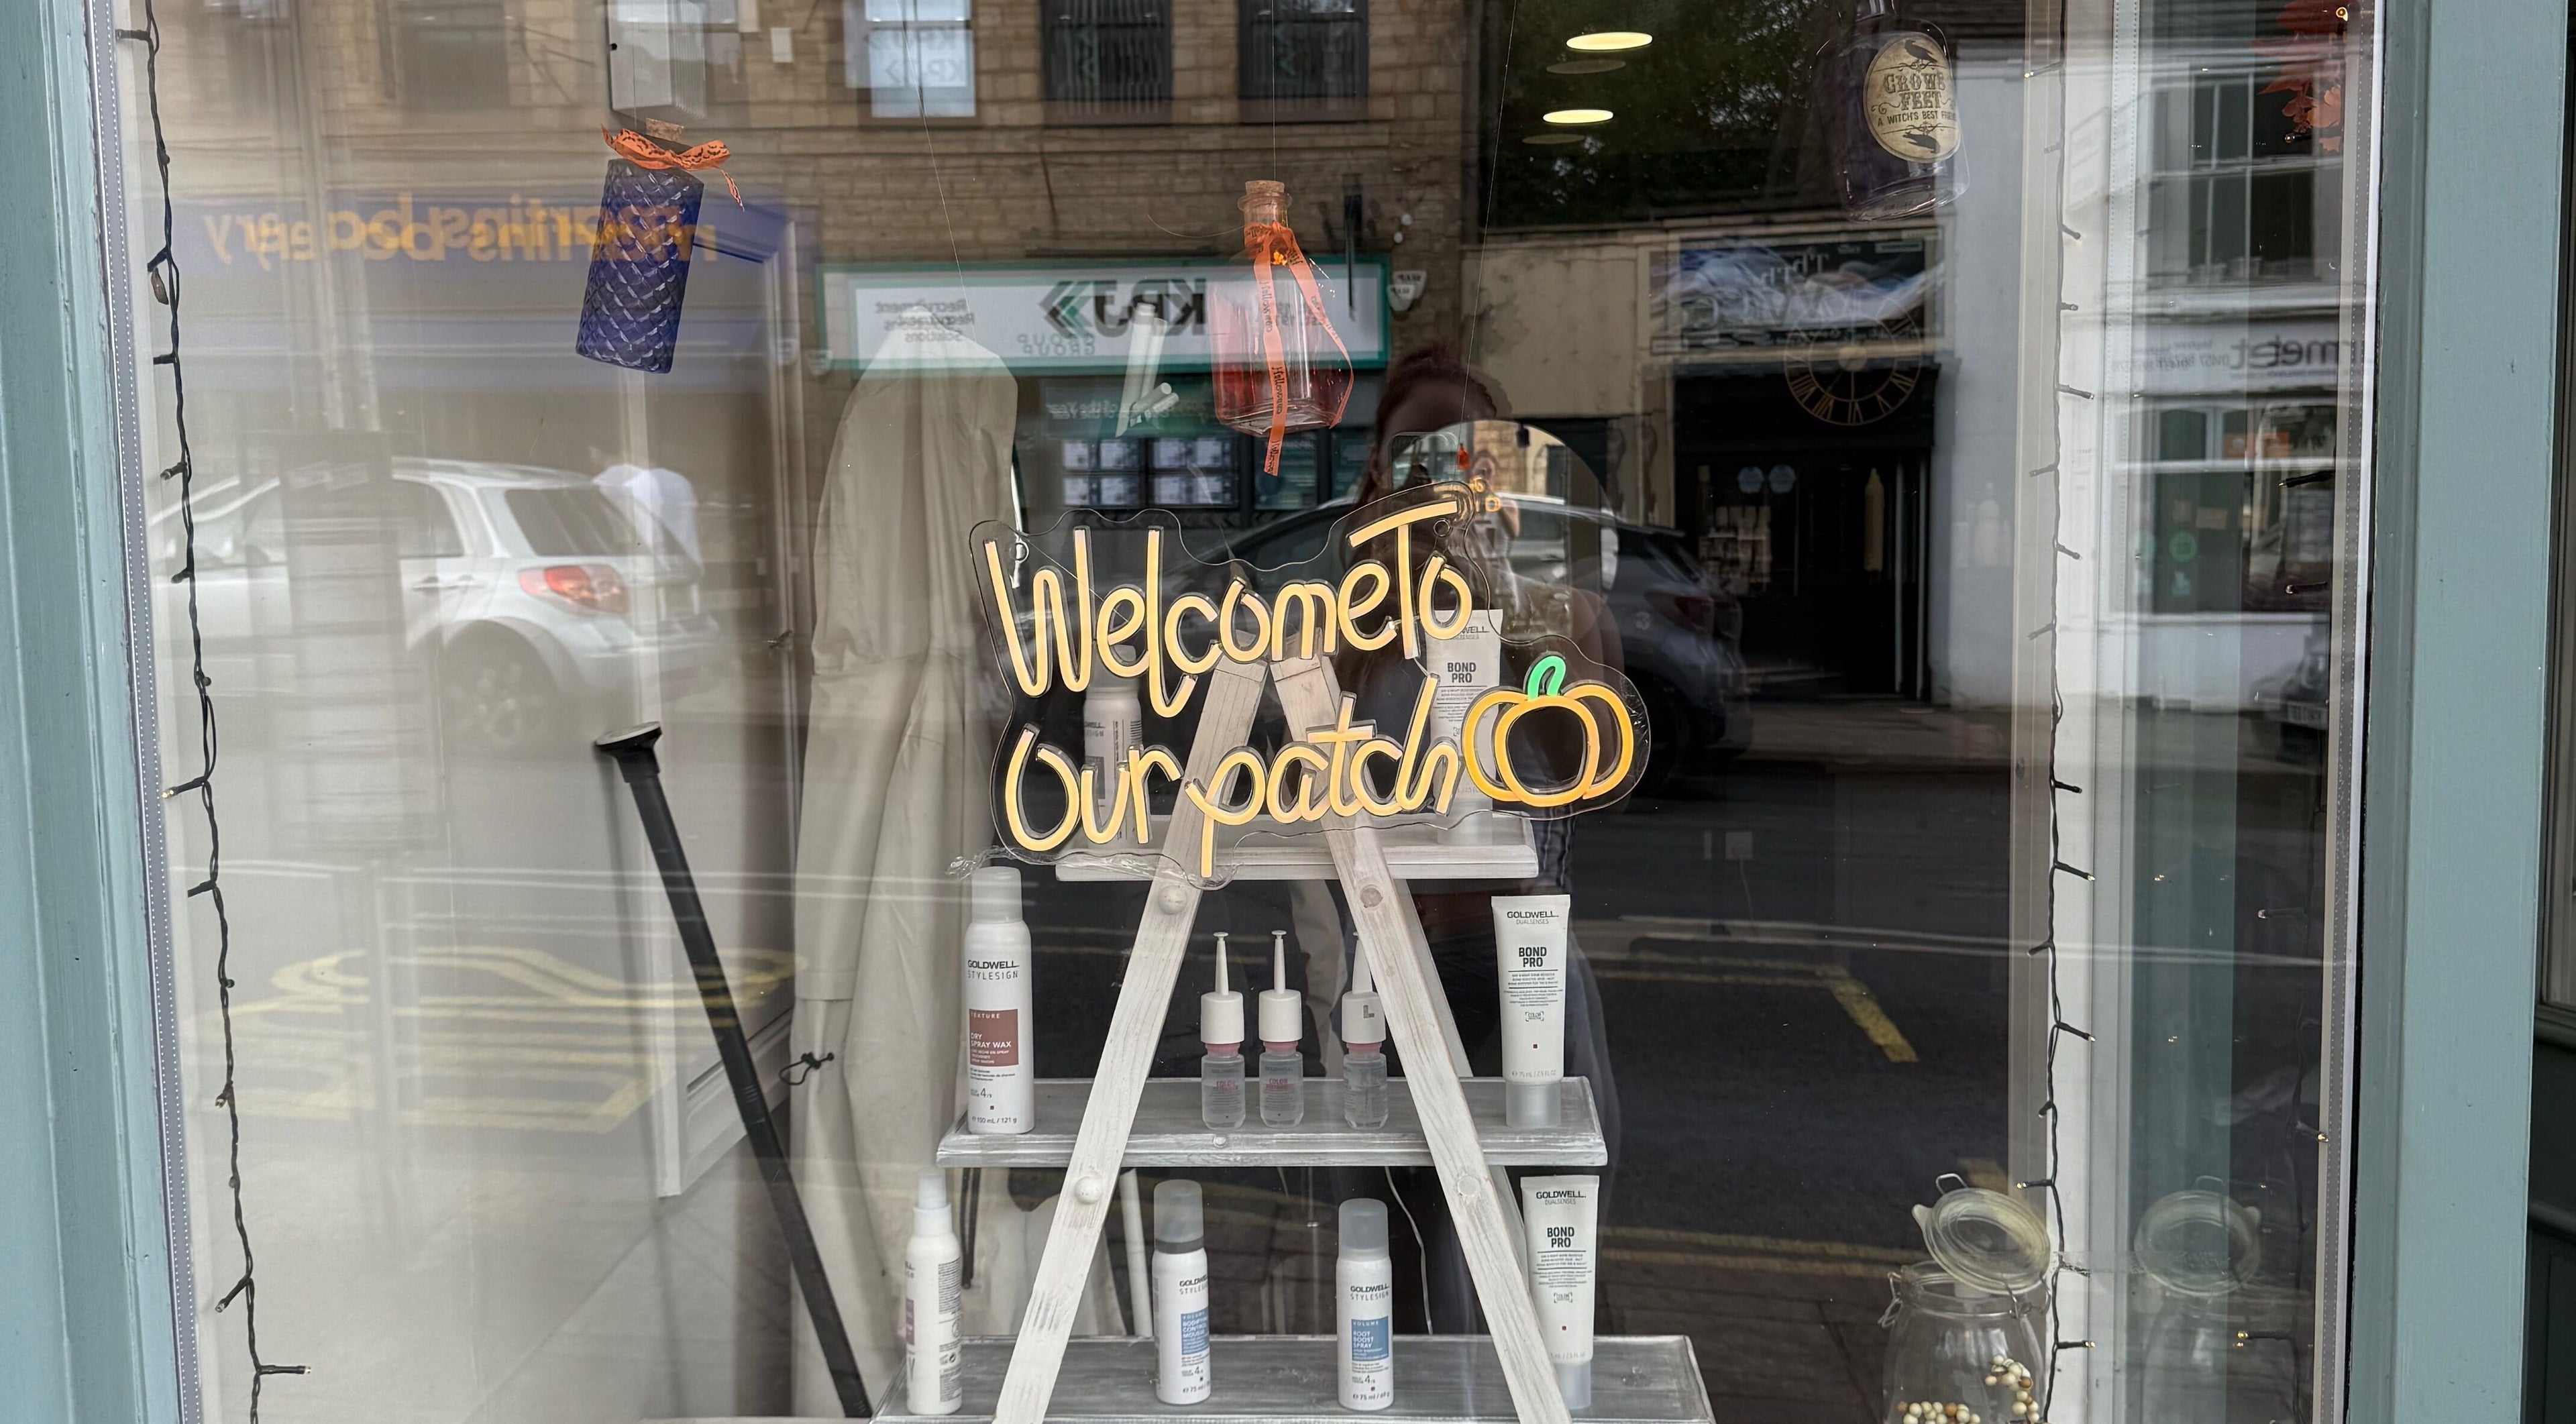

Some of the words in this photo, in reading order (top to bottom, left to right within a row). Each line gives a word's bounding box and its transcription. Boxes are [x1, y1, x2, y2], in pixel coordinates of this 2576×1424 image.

[1899, 91, 1943, 111] FEET
[1877, 117, 1883, 127] A
[1887, 111, 1919, 125] WITCH'S
[1922, 110, 1939, 119] BEST
[1448, 663, 1477, 672] BOND
[1452, 673, 1472, 683] PRO
[1184, 673, 1460, 878] patch
[1519, 947, 1547, 957] BOND
[1523, 957, 1543, 967] PRO
[967, 971, 1018, 980] STYLESIGN
[1547, 1227, 1574, 1238] BOND
[1551, 1238, 1571, 1248] PRO
